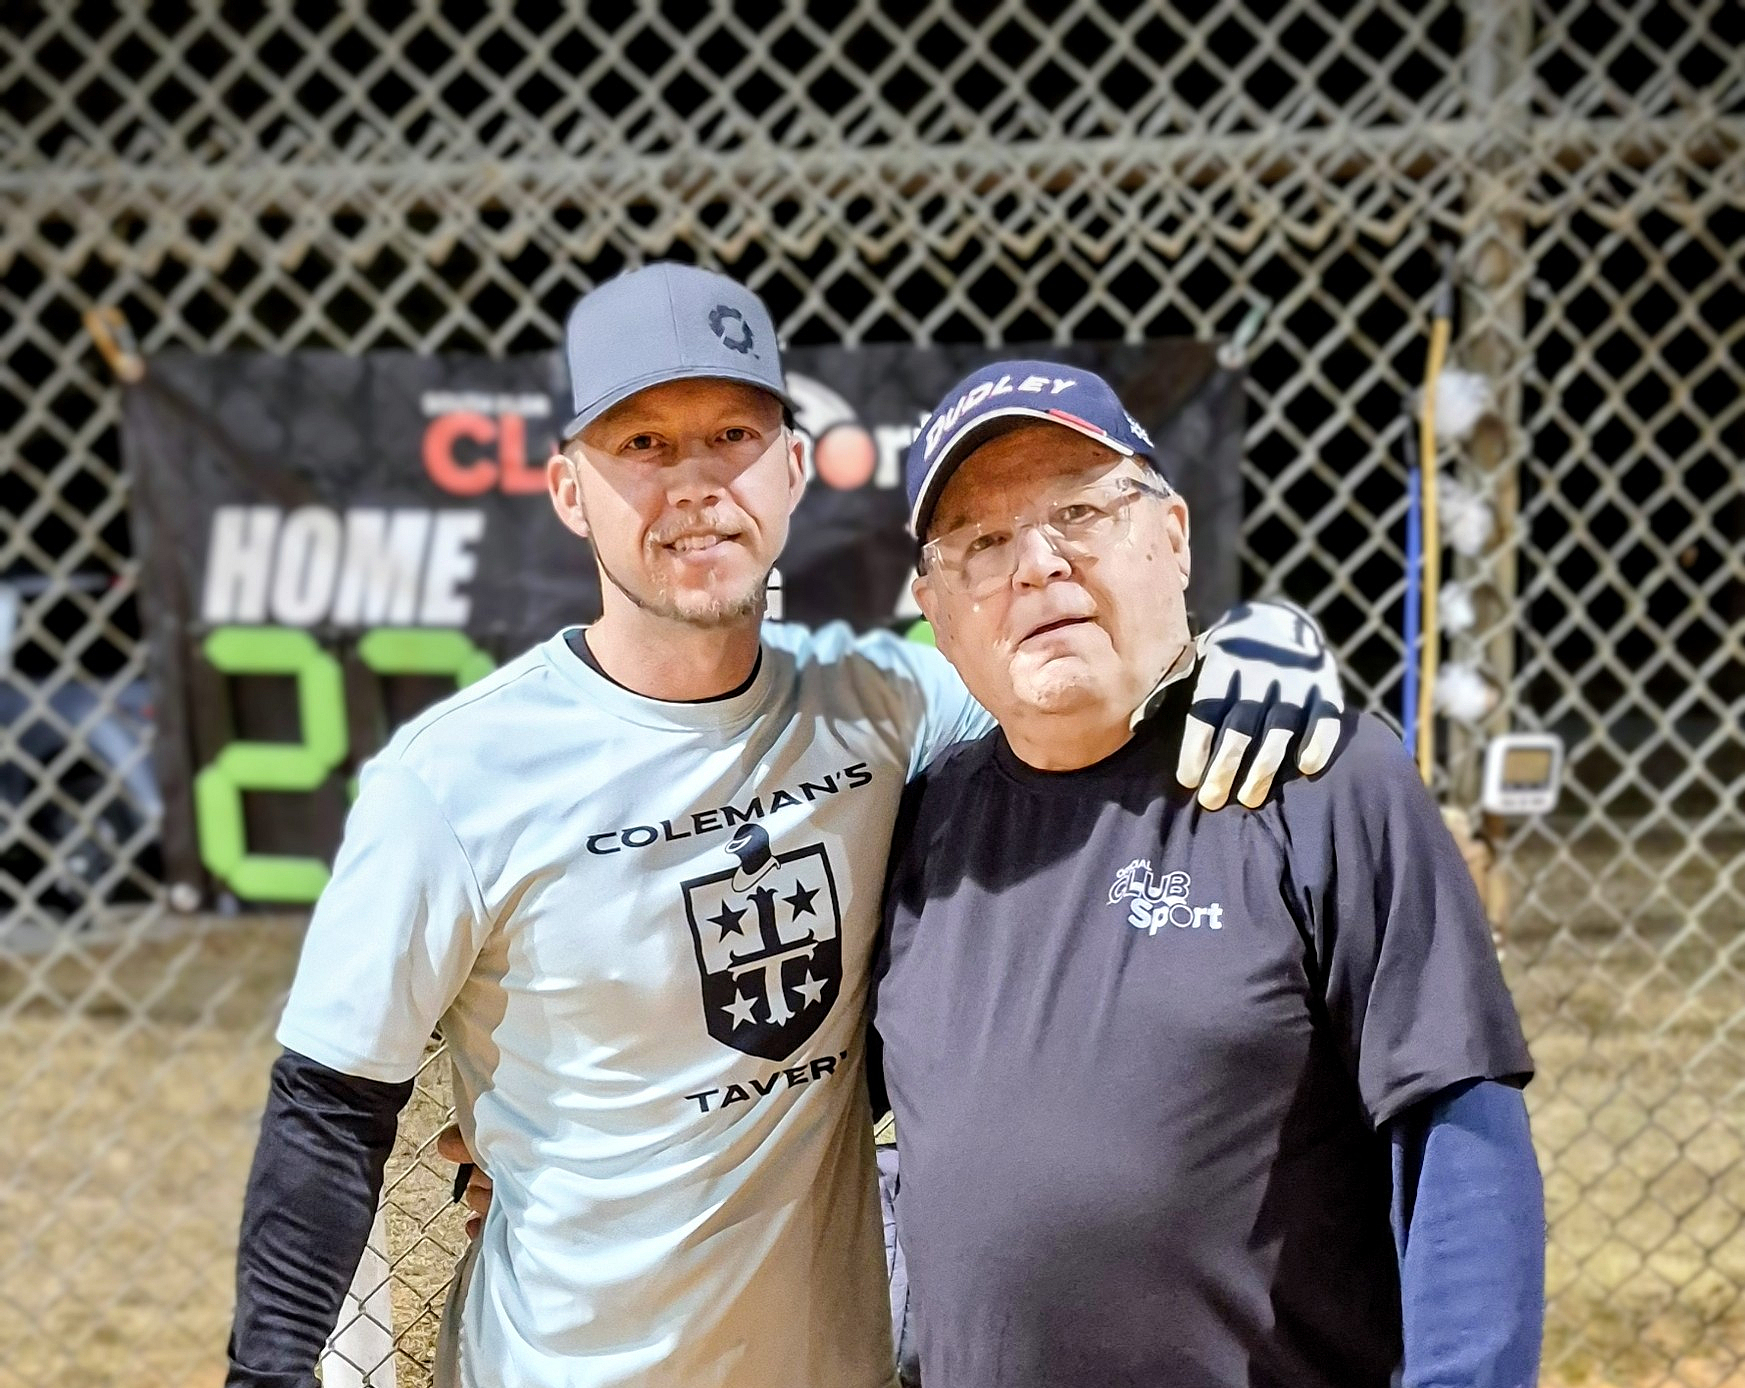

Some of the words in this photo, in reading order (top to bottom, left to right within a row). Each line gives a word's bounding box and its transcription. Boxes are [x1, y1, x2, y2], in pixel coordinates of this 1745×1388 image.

[923, 374, 1076, 462] DUDLEY
[203, 506, 486, 627] HOME
[585, 761, 874, 856] COLEMAN'S
[1106, 870, 1192, 906] CLUB
[1127, 897, 1224, 937] Sport
[683, 1049, 849, 1114] TAVER
